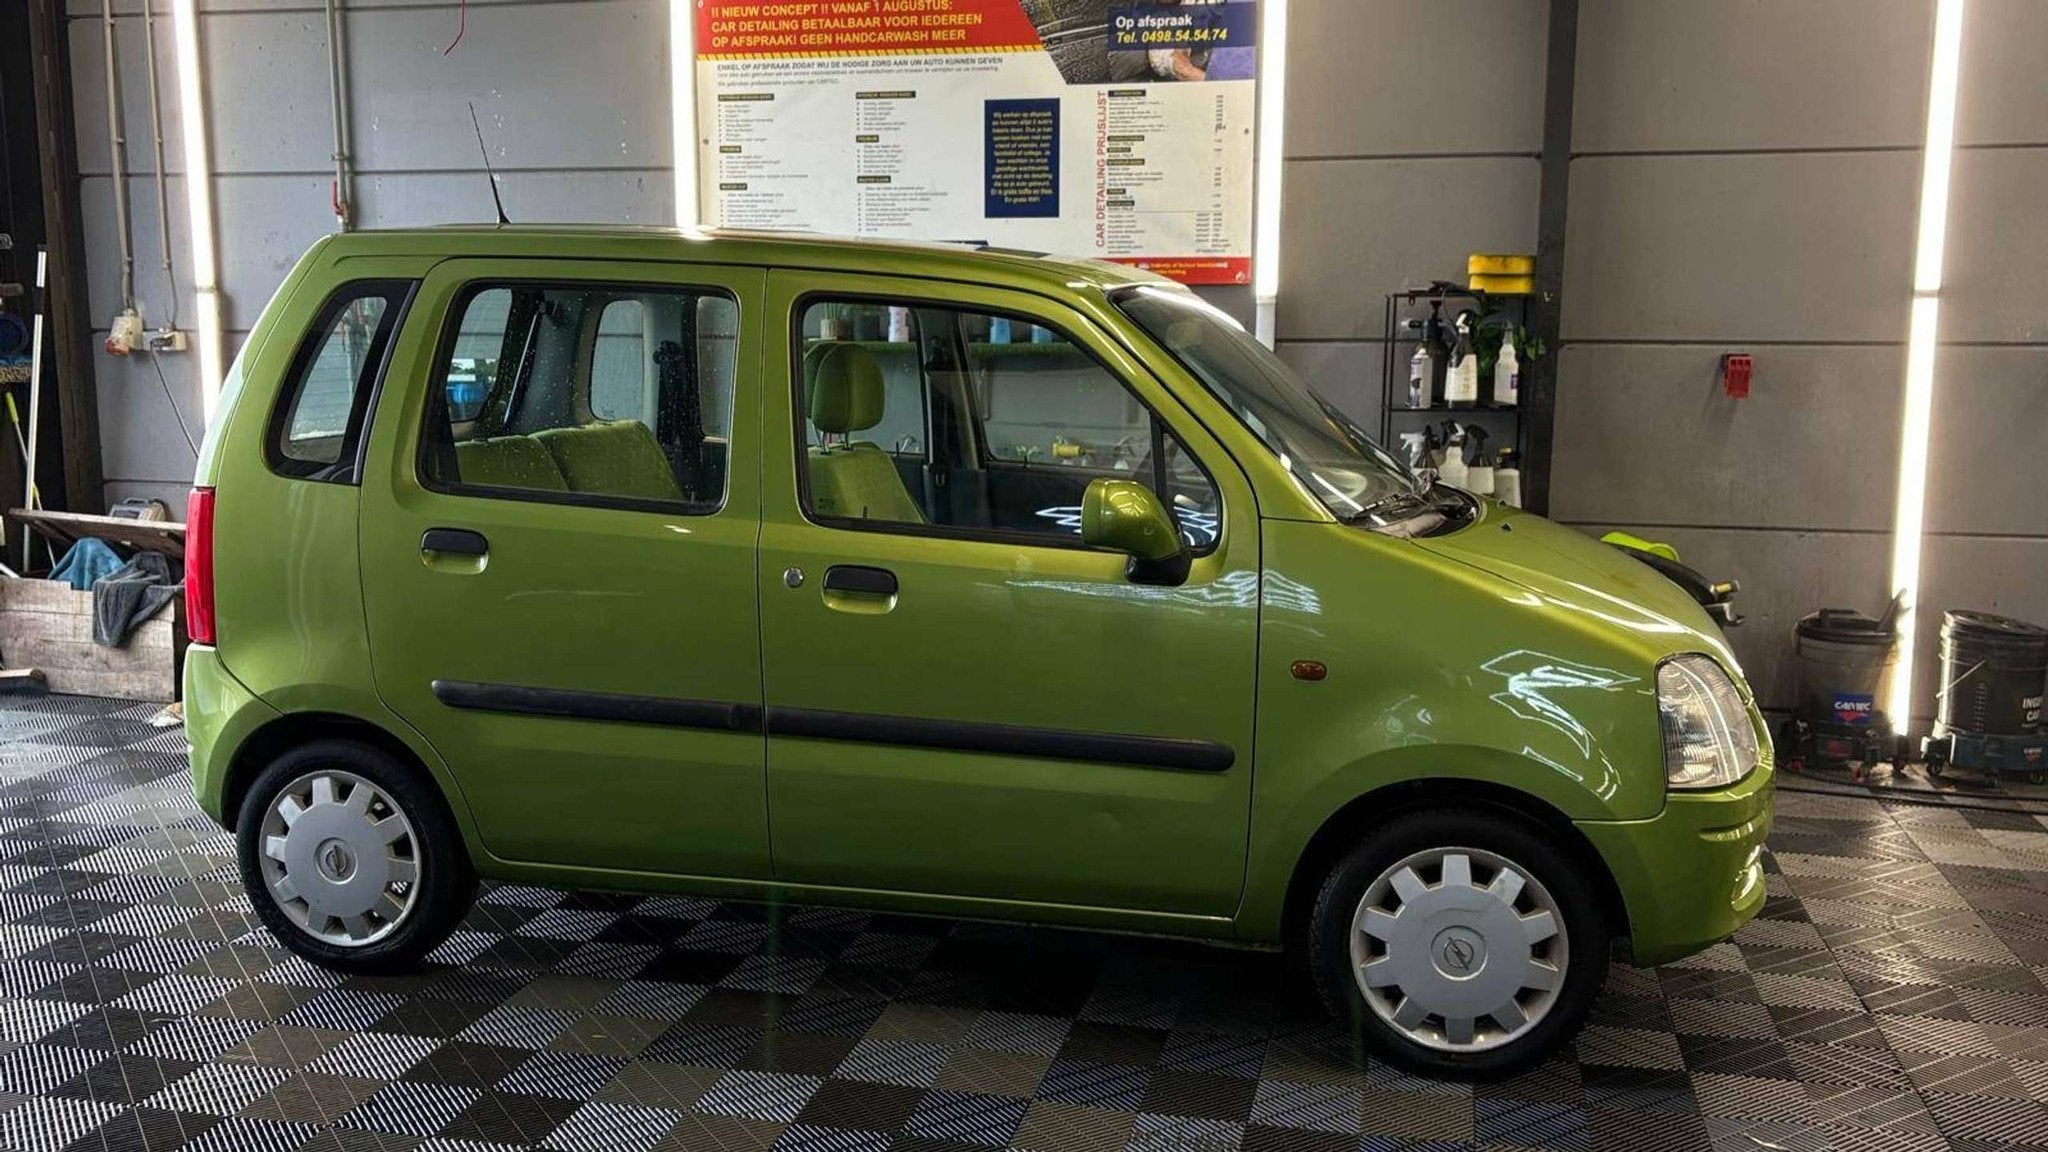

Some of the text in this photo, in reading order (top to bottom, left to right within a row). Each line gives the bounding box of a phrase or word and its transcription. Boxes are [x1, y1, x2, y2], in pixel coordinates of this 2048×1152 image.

[721, 6, 760, 18] NIEUW
[762, 4, 817, 16] CONCEPT
[831, 2, 871, 14] VANAF
[882, 0, 952, 12] AUGUSTUS:
[711, 13, 982, 33] CAR DETAILING BETAALBAAR VOOR IEDEREEN
[1116, 14, 1192, 30] Op afspraak
[712, 30, 966, 48] OP AFSPRAAK! GEEN HANDCARWASH MEER
[1116, 28, 1227, 43] Tel. 0498.54.54.74
[1095, 90, 1107, 248] CAR DETAILING PRIJSLIJST
